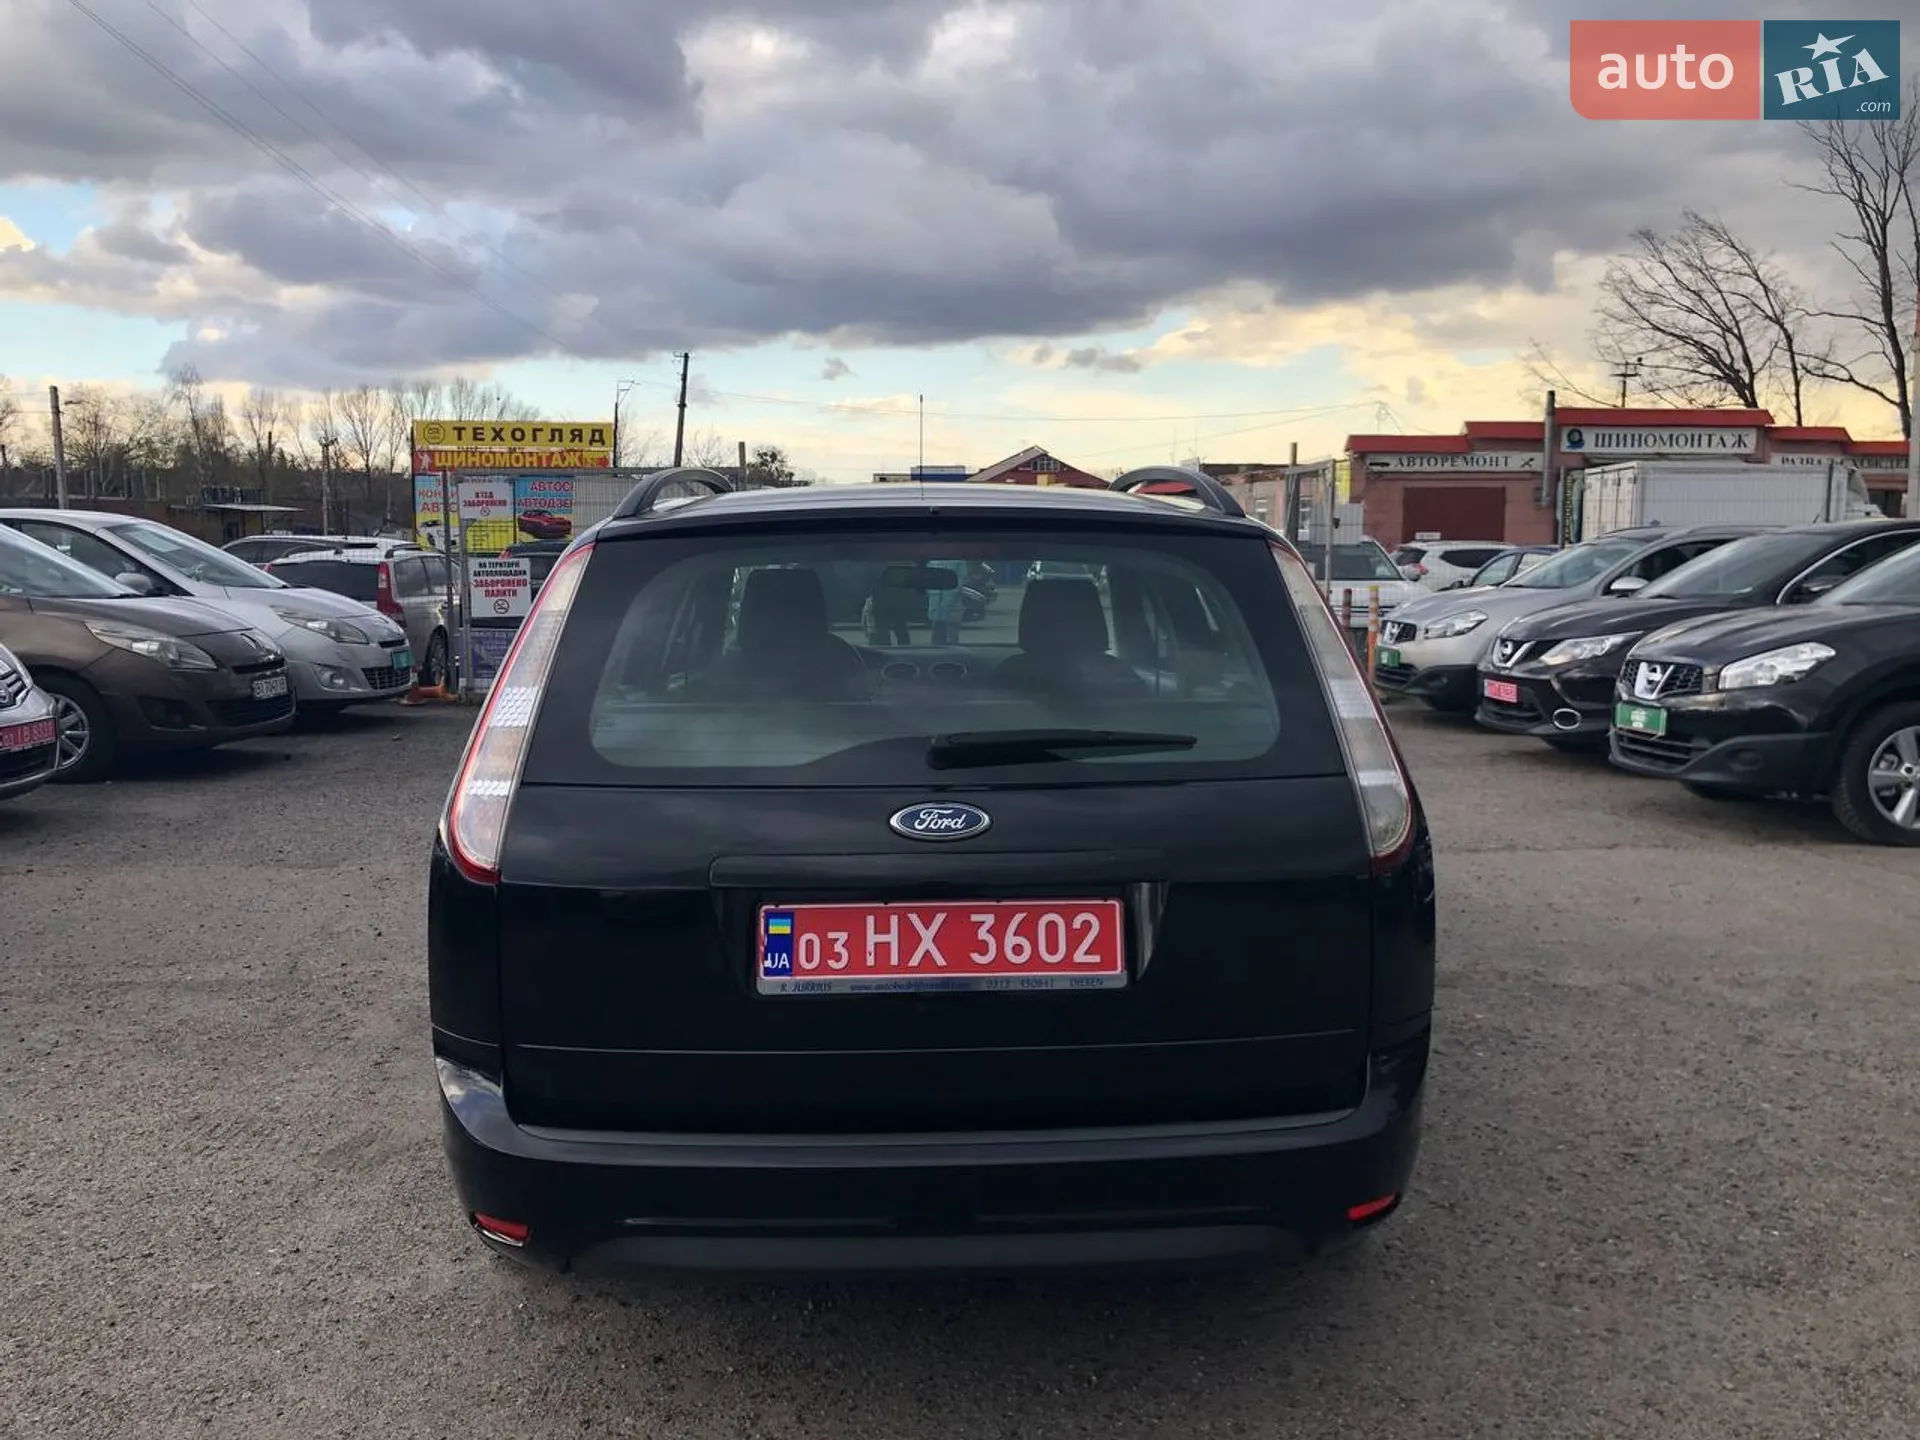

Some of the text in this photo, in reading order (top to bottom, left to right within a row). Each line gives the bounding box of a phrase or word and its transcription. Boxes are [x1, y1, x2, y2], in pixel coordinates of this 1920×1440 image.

[453, 427, 606, 446] ТЕХОГЛЯД
[1594, 432, 1749, 448] ШИНОМОНТАЖ
[435, 451, 581, 468] ШИНОМОНТАЖ
[1394, 456, 1511, 468] АВТОРЕМОНТ
[478, 561, 487, 569] НА
[473, 578, 528, 588] ЗАБОРОНЕНО
[484, 589, 517, 597] ПАЛИТИ
[914, 808, 967, 830] Ford
[798, 911, 1101, 971] 03 HX 3602
[767, 952, 790, 969] UA
